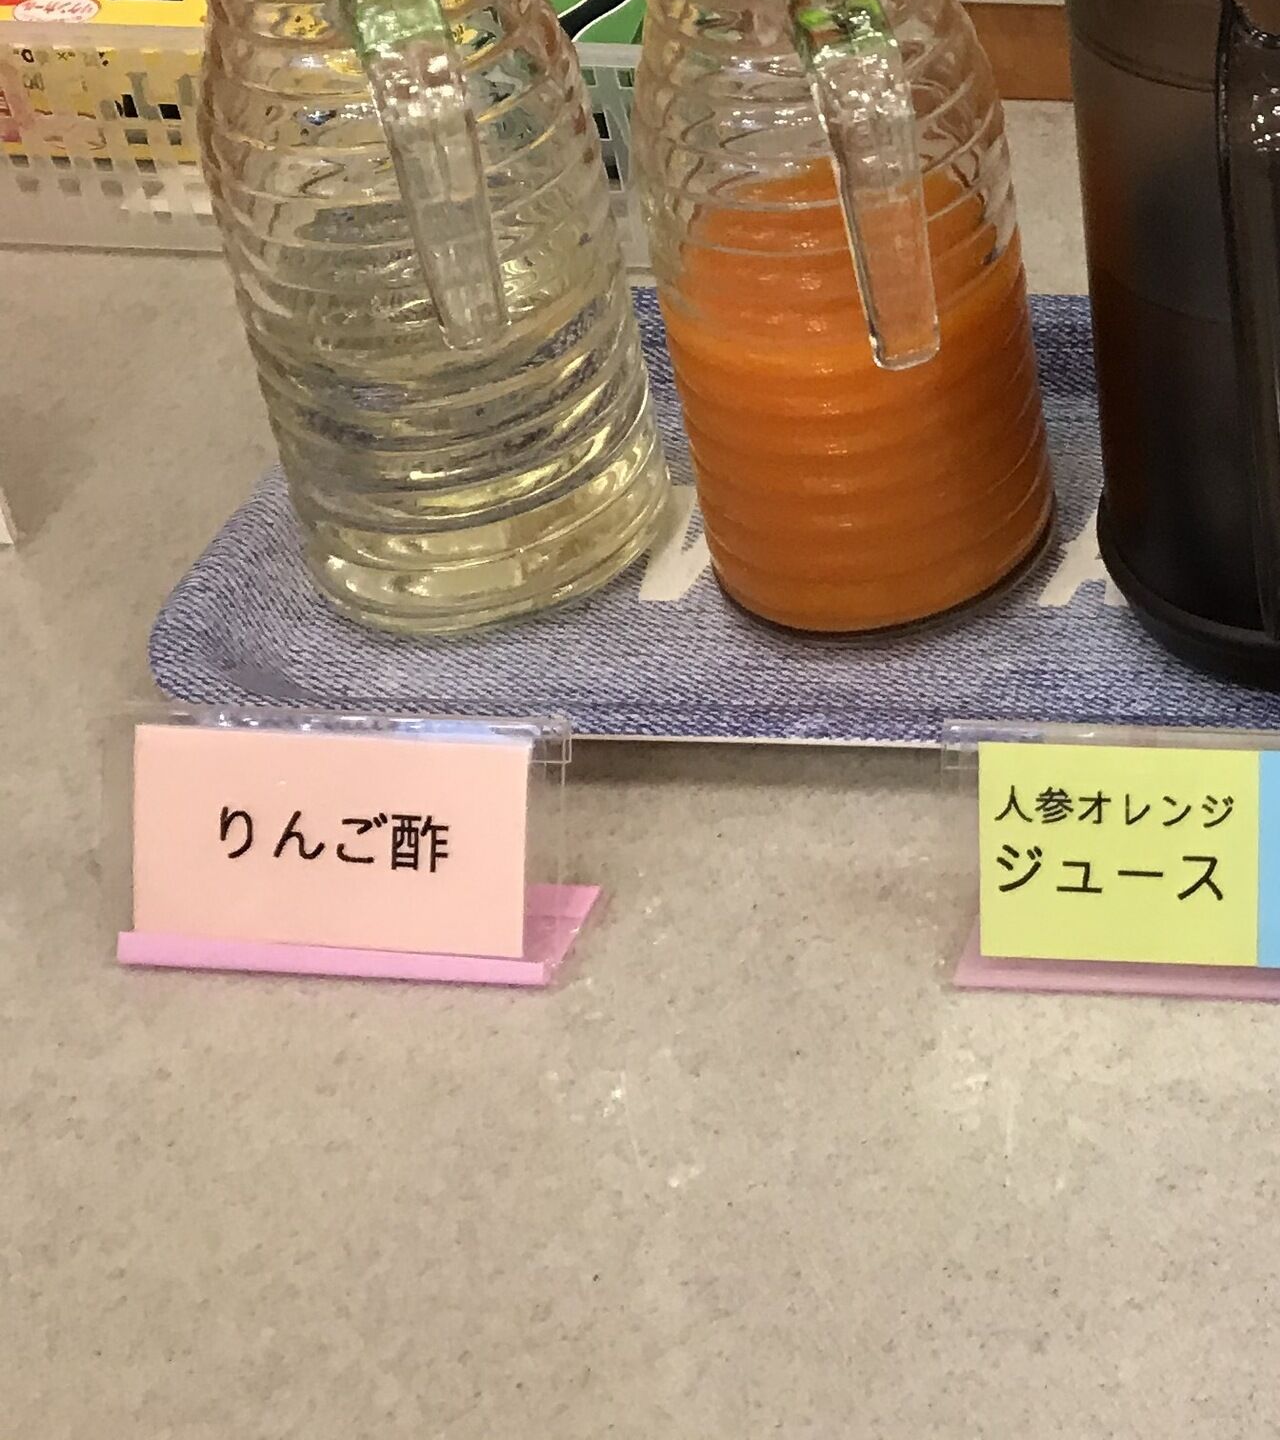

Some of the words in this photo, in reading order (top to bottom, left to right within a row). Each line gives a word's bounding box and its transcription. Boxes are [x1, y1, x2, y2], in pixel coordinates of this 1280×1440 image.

[994, 784, 1234, 829] 人参オレンジ
[218, 805, 450, 874] りんご酢
[996, 843, 1225, 902] ジュース
